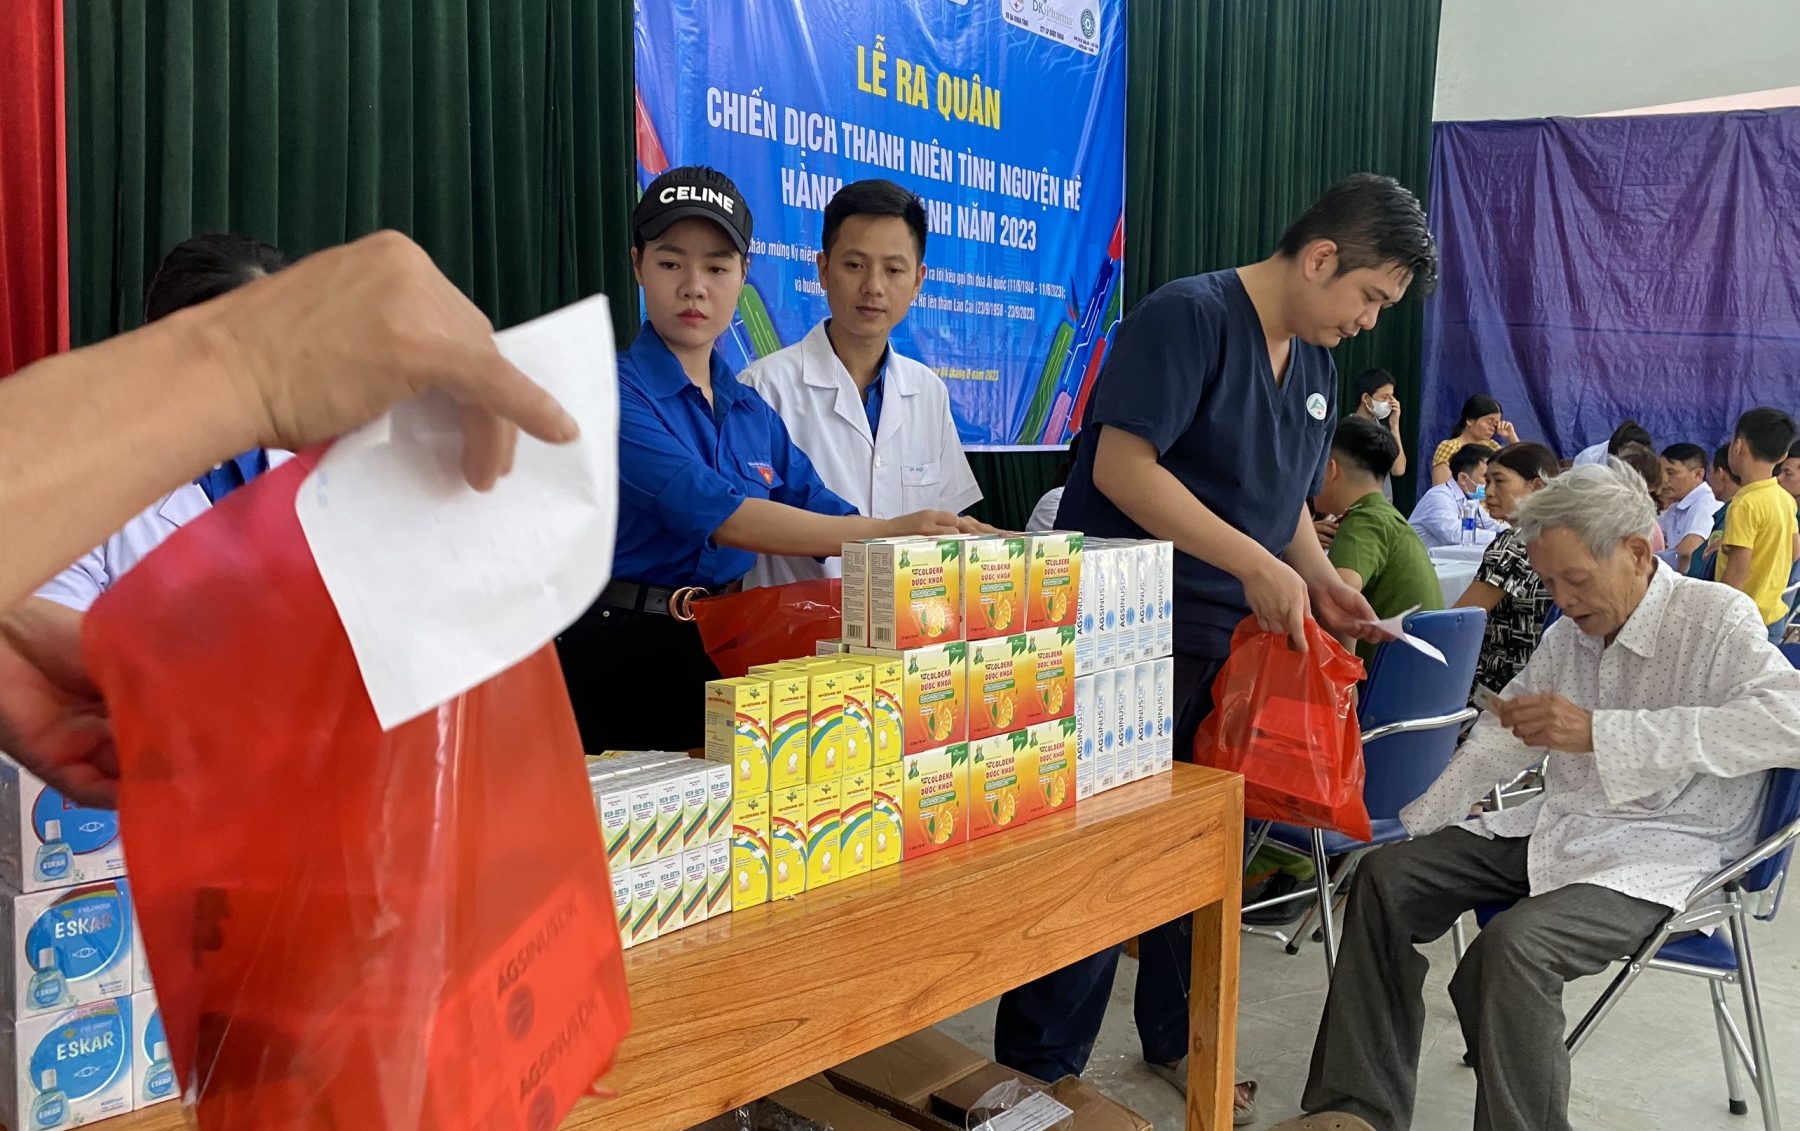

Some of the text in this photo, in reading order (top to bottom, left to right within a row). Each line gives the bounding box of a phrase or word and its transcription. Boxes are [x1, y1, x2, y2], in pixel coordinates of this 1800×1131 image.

[857, 34, 1000, 130] LỄ RA QUÂN
[706, 86, 1082, 211] CHIẾN DỊCH THANH NIÊN TÌNH NGUYỆN HÈ
[659, 186, 734, 214] CELINE
[957, 201, 995, 244] NĂM
[1000, 214, 1037, 251] 2023
[768, 240, 790, 260] mừng
[57, 1031, 114, 1061] ESKAR
